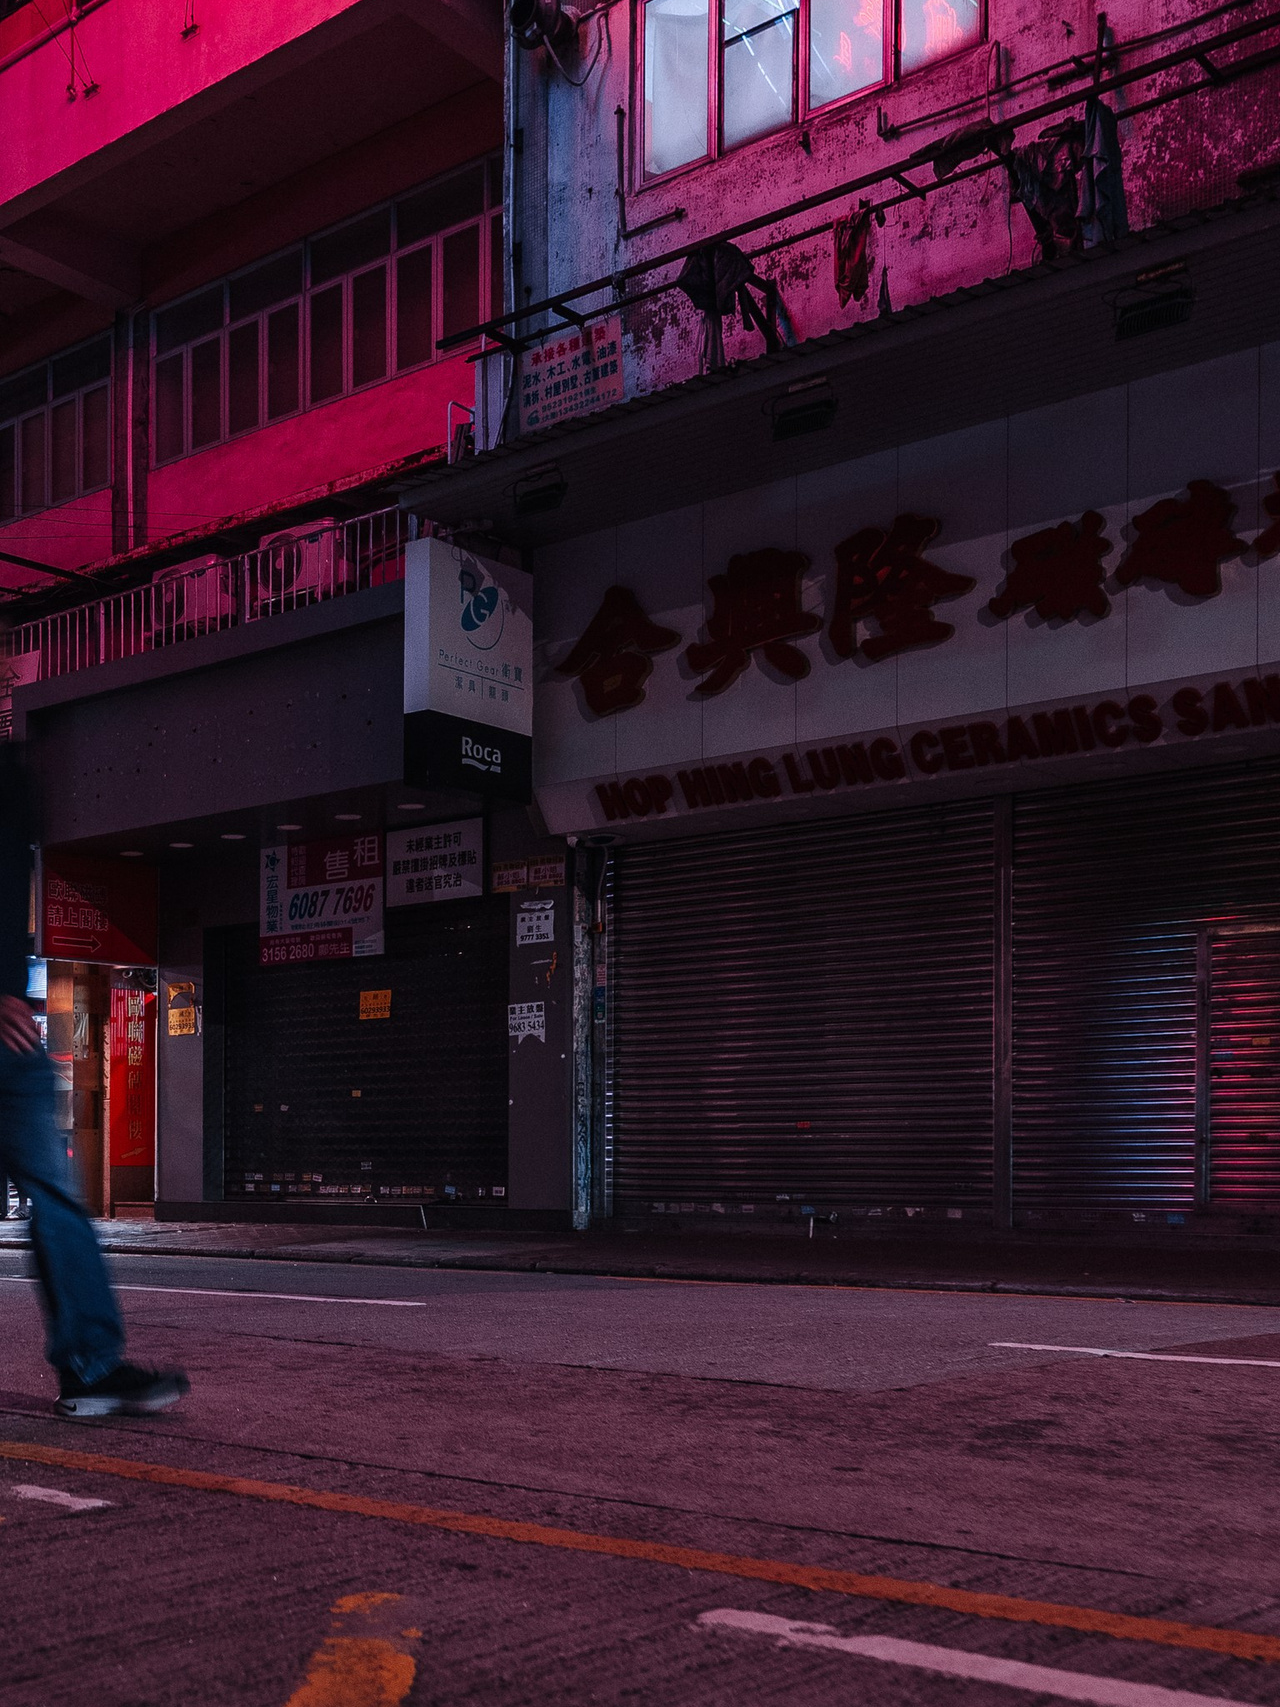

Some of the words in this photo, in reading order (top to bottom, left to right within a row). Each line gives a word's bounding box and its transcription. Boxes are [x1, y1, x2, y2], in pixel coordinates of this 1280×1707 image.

[439, 649, 472, 669] Perfect
[476, 660, 499, 676] Gear
[461, 735, 502, 764] Roca
[595, 774, 674, 822] HOP
[678, 758, 781, 810] HING
[783, 736, 904, 796] LUNG
[909, 694, 1164, 776] CERAMICS
[288, 889, 331, 921] 6087
[333, 883, 376, 915] 7696
[262, 945, 287, 962] 3156
[289, 942, 315, 961] 2680
[508, 1022, 526, 1033] 9683
[527, 1020, 545, 1032] 5434
